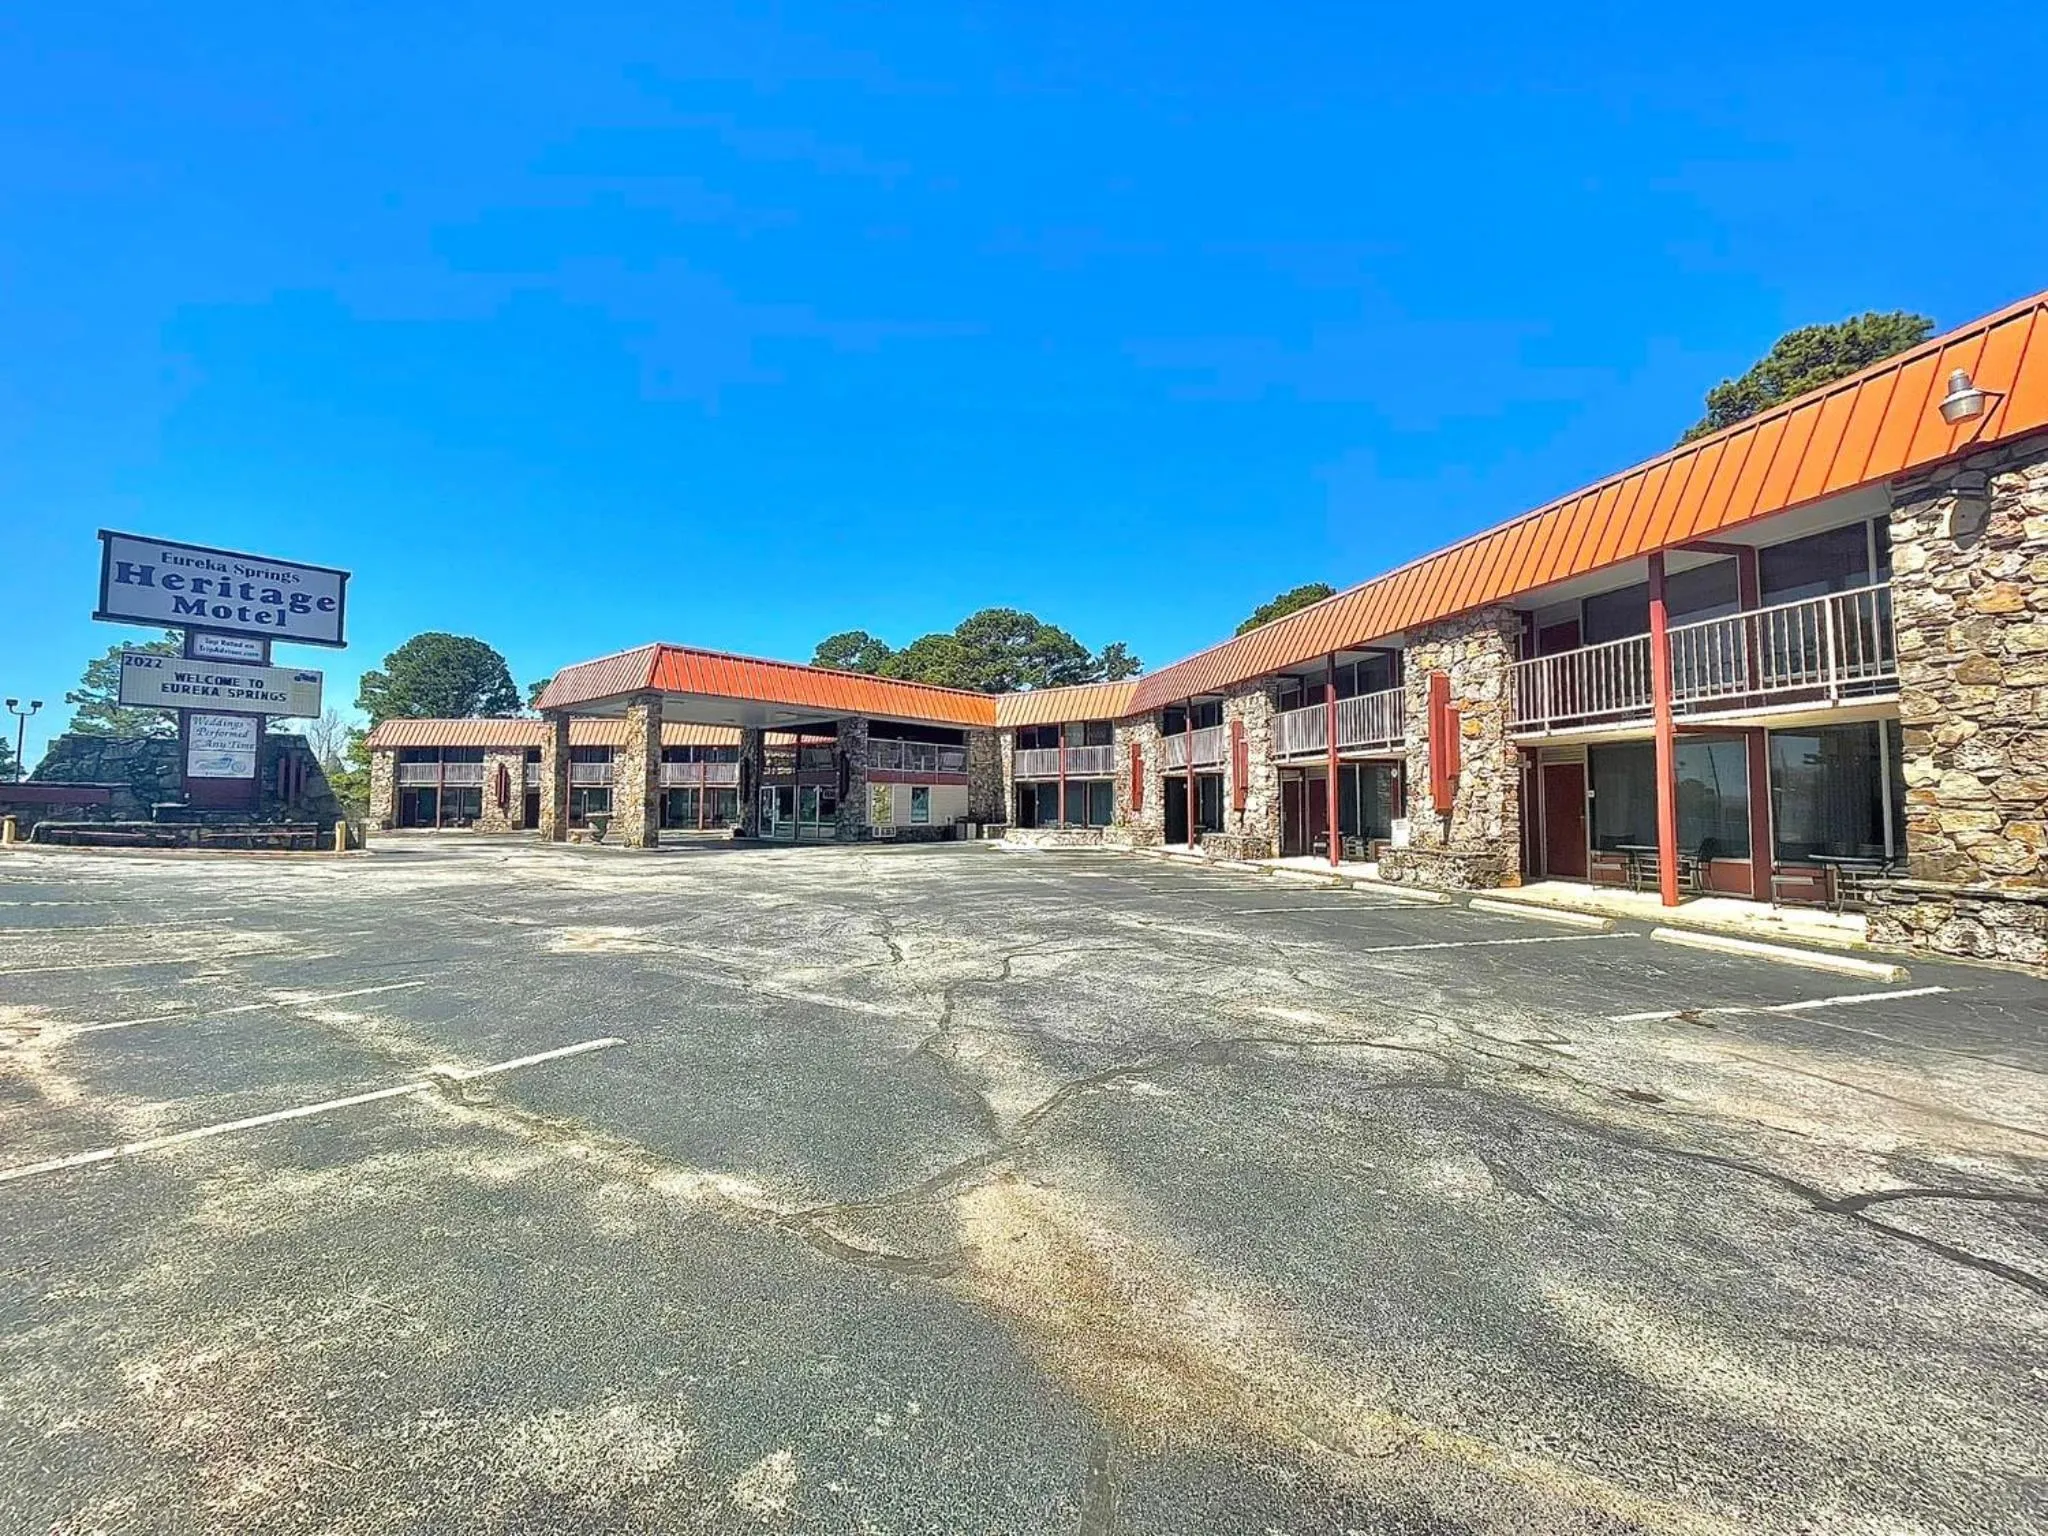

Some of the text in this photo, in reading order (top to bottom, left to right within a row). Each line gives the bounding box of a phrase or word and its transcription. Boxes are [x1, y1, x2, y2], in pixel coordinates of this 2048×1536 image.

[161, 551, 301, 584] Eureka Springs
[115, 561, 337, 614] Heritage
[172, 595, 287, 627] Motel
[124, 655, 163, 669] 2022
[174, 671, 264, 689] WELCOME TO
[161, 682, 288, 702] EUREKA SPRINGS
[192, 716, 245, 729] Weddings
[196, 727, 250, 739] Performed
